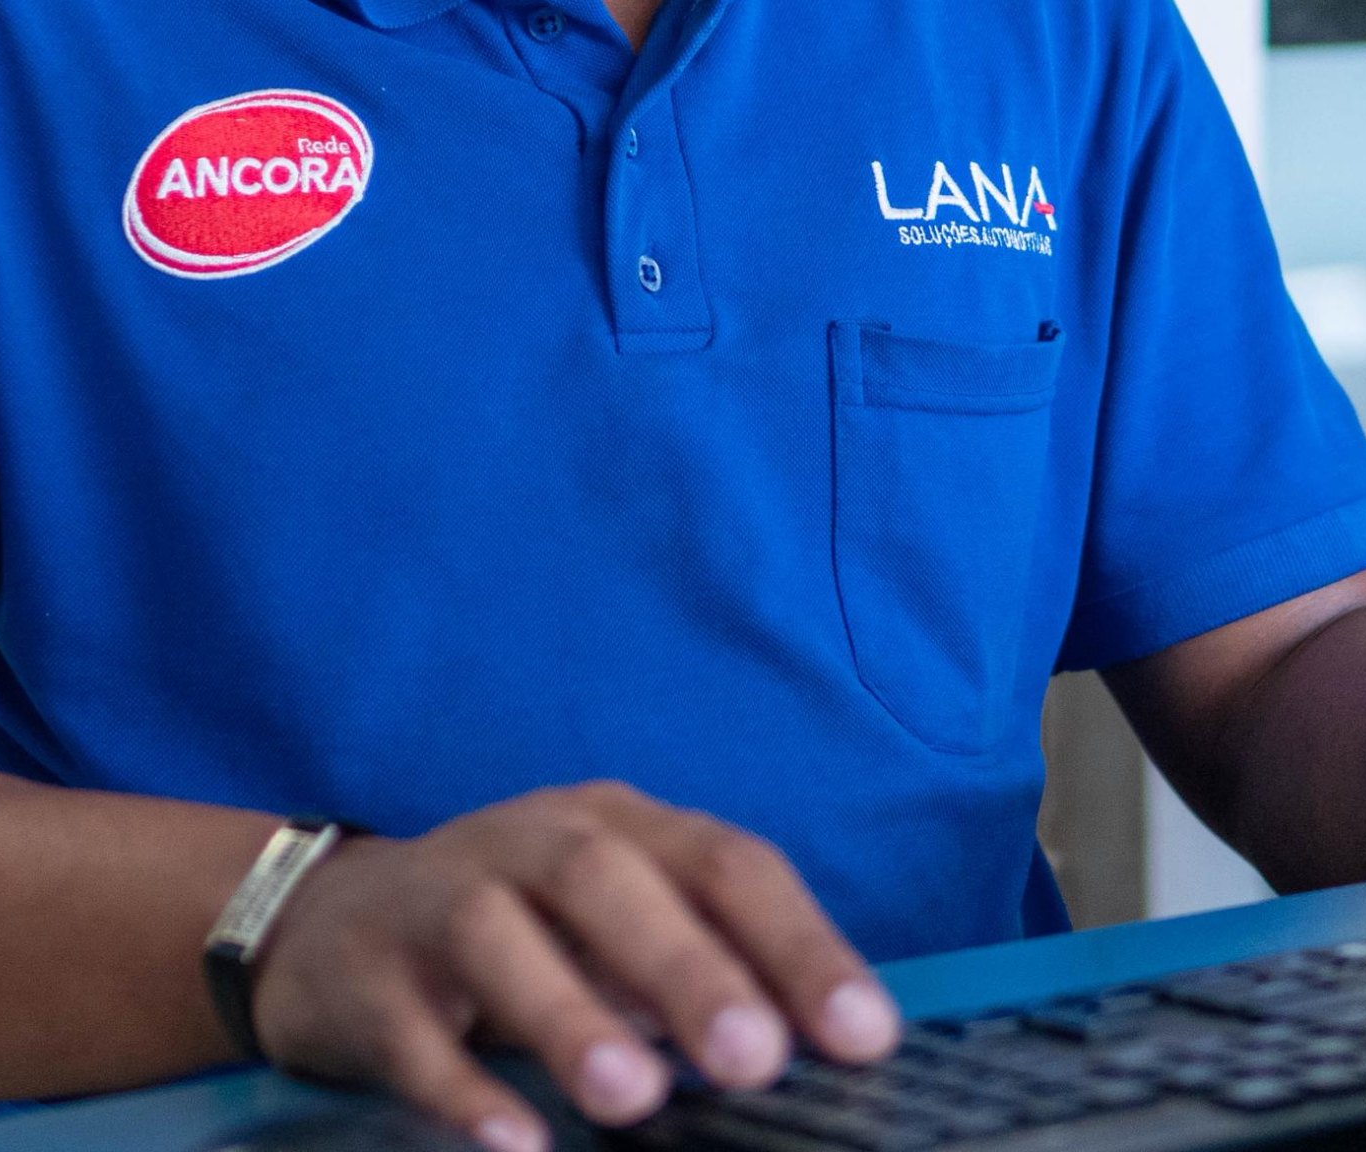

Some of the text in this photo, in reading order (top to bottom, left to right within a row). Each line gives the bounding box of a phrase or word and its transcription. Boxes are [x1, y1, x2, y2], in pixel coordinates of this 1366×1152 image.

[298, 136, 351, 154] Rede
[156, 156, 363, 200] ANCORA
[871, 160, 1057, 231] LANA
[898, 221, 981, 248] SOLUÇÕES
